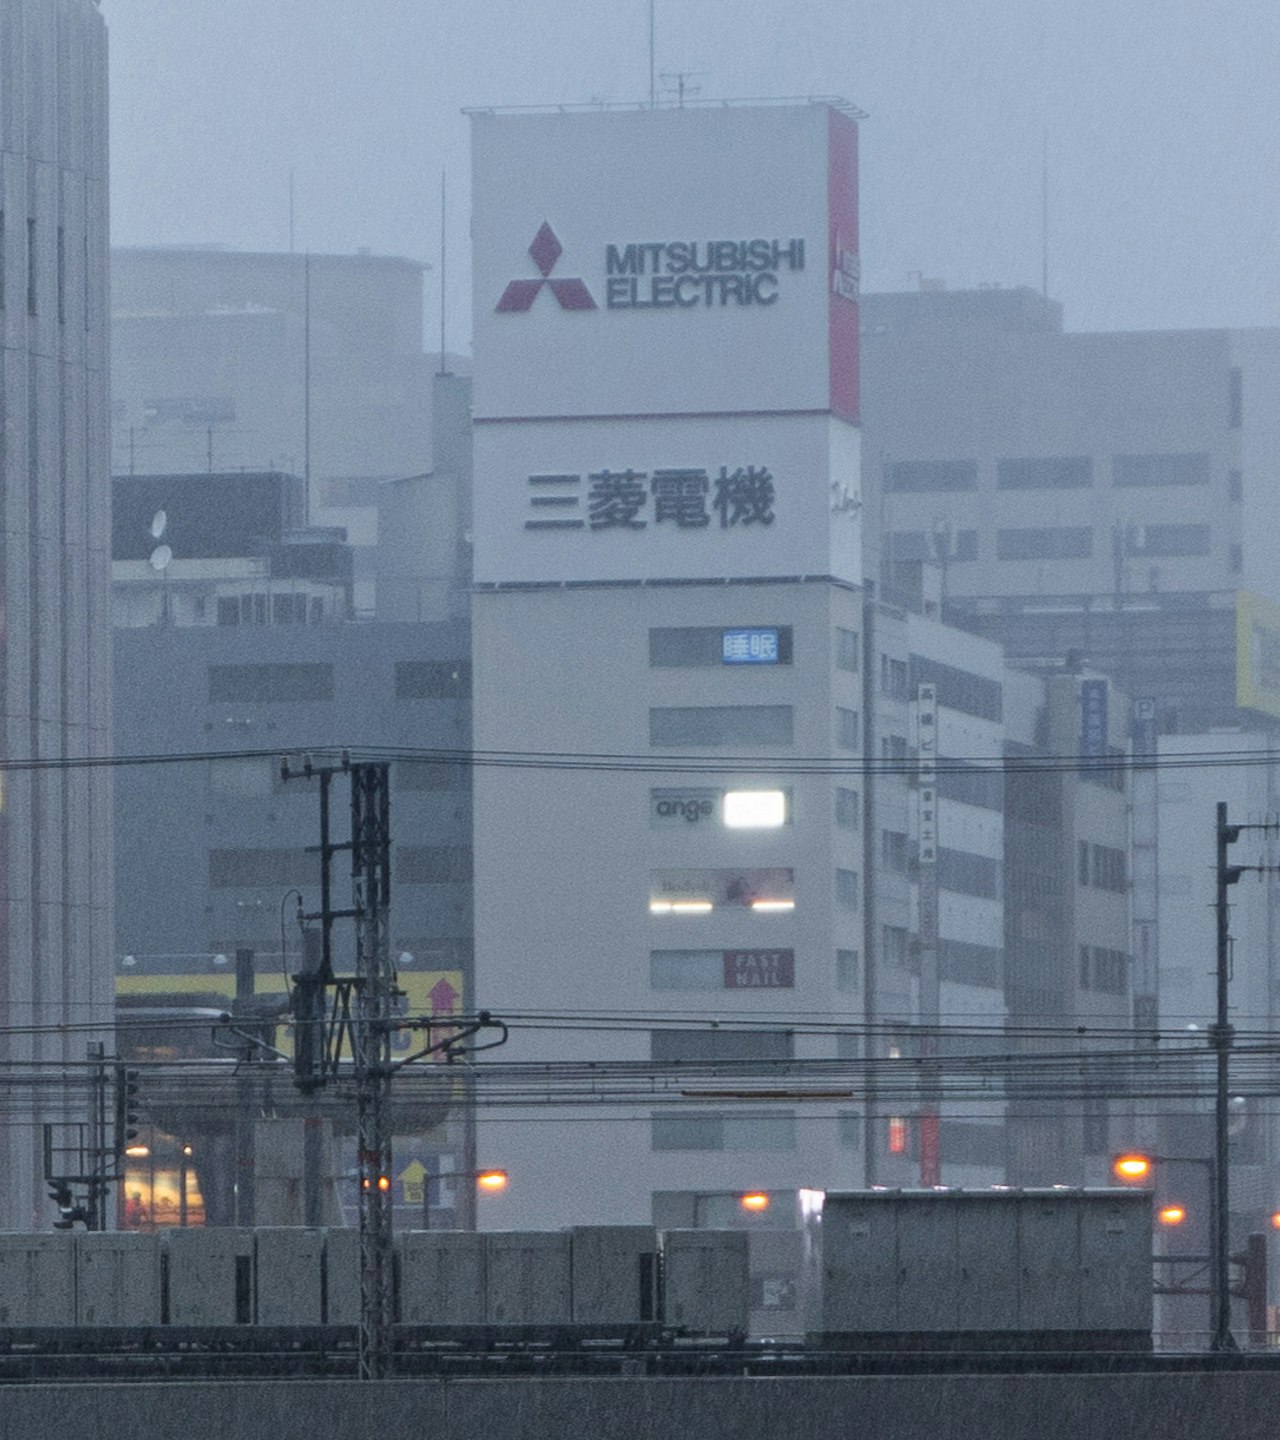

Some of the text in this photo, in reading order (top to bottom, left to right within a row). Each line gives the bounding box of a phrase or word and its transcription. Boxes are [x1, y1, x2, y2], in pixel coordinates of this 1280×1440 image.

[605, 237, 805, 274] MITSUBISHI
[605, 273, 779, 310] ELECTRIC
[524, 464, 776, 530] 三菱電機
[723, 629, 777, 662] 睡眠
[656, 799, 713, 822] ange
[735, 954, 779, 967] FAST
